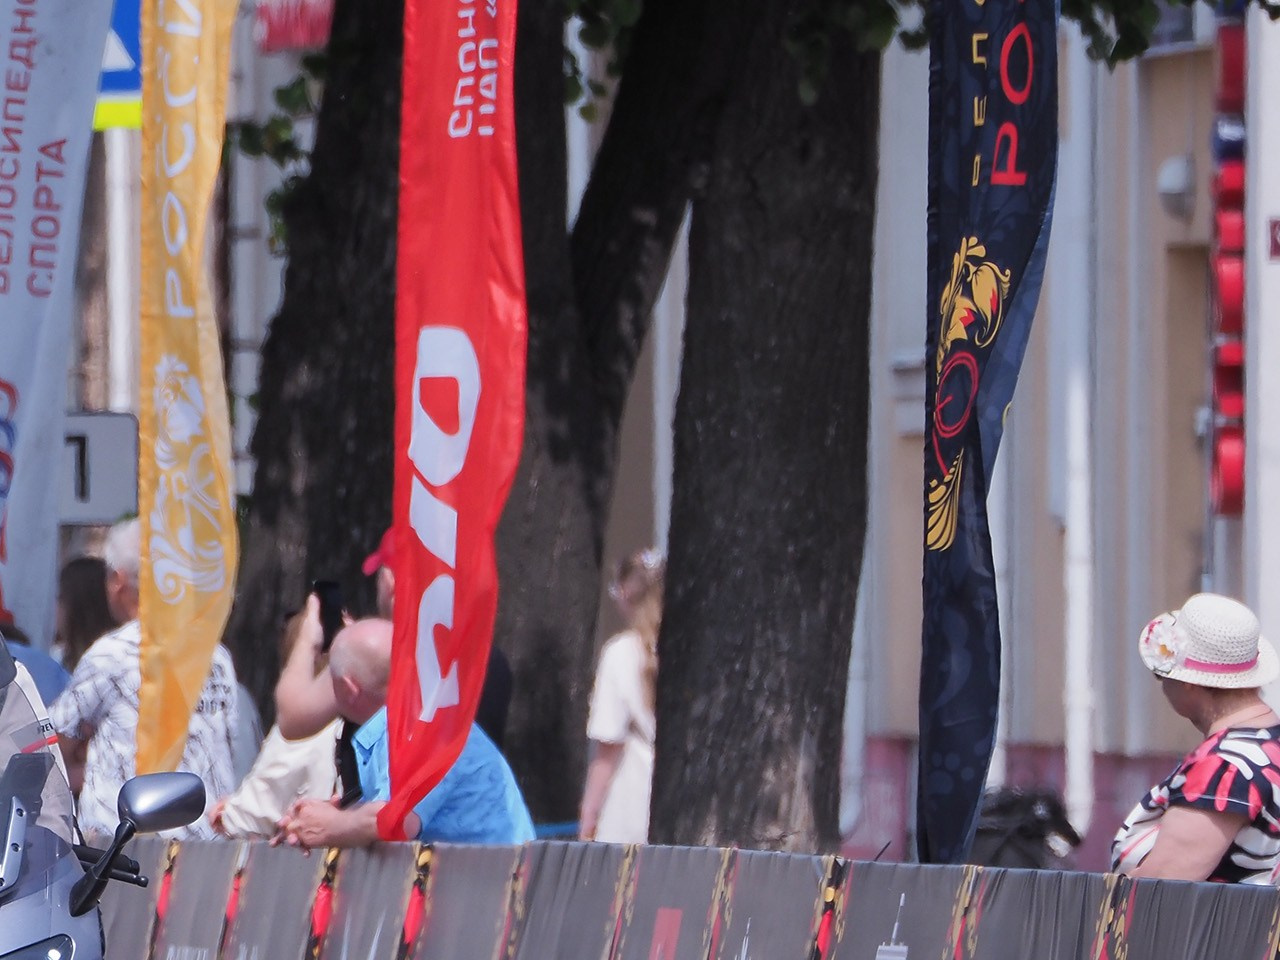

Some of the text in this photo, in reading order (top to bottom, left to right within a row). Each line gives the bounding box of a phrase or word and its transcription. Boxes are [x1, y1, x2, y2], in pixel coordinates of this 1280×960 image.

[448, 0, 476, 138] СПОН
[990, 0, 1033, 187] РО
[26, 138, 69, 299] СПОРТА
